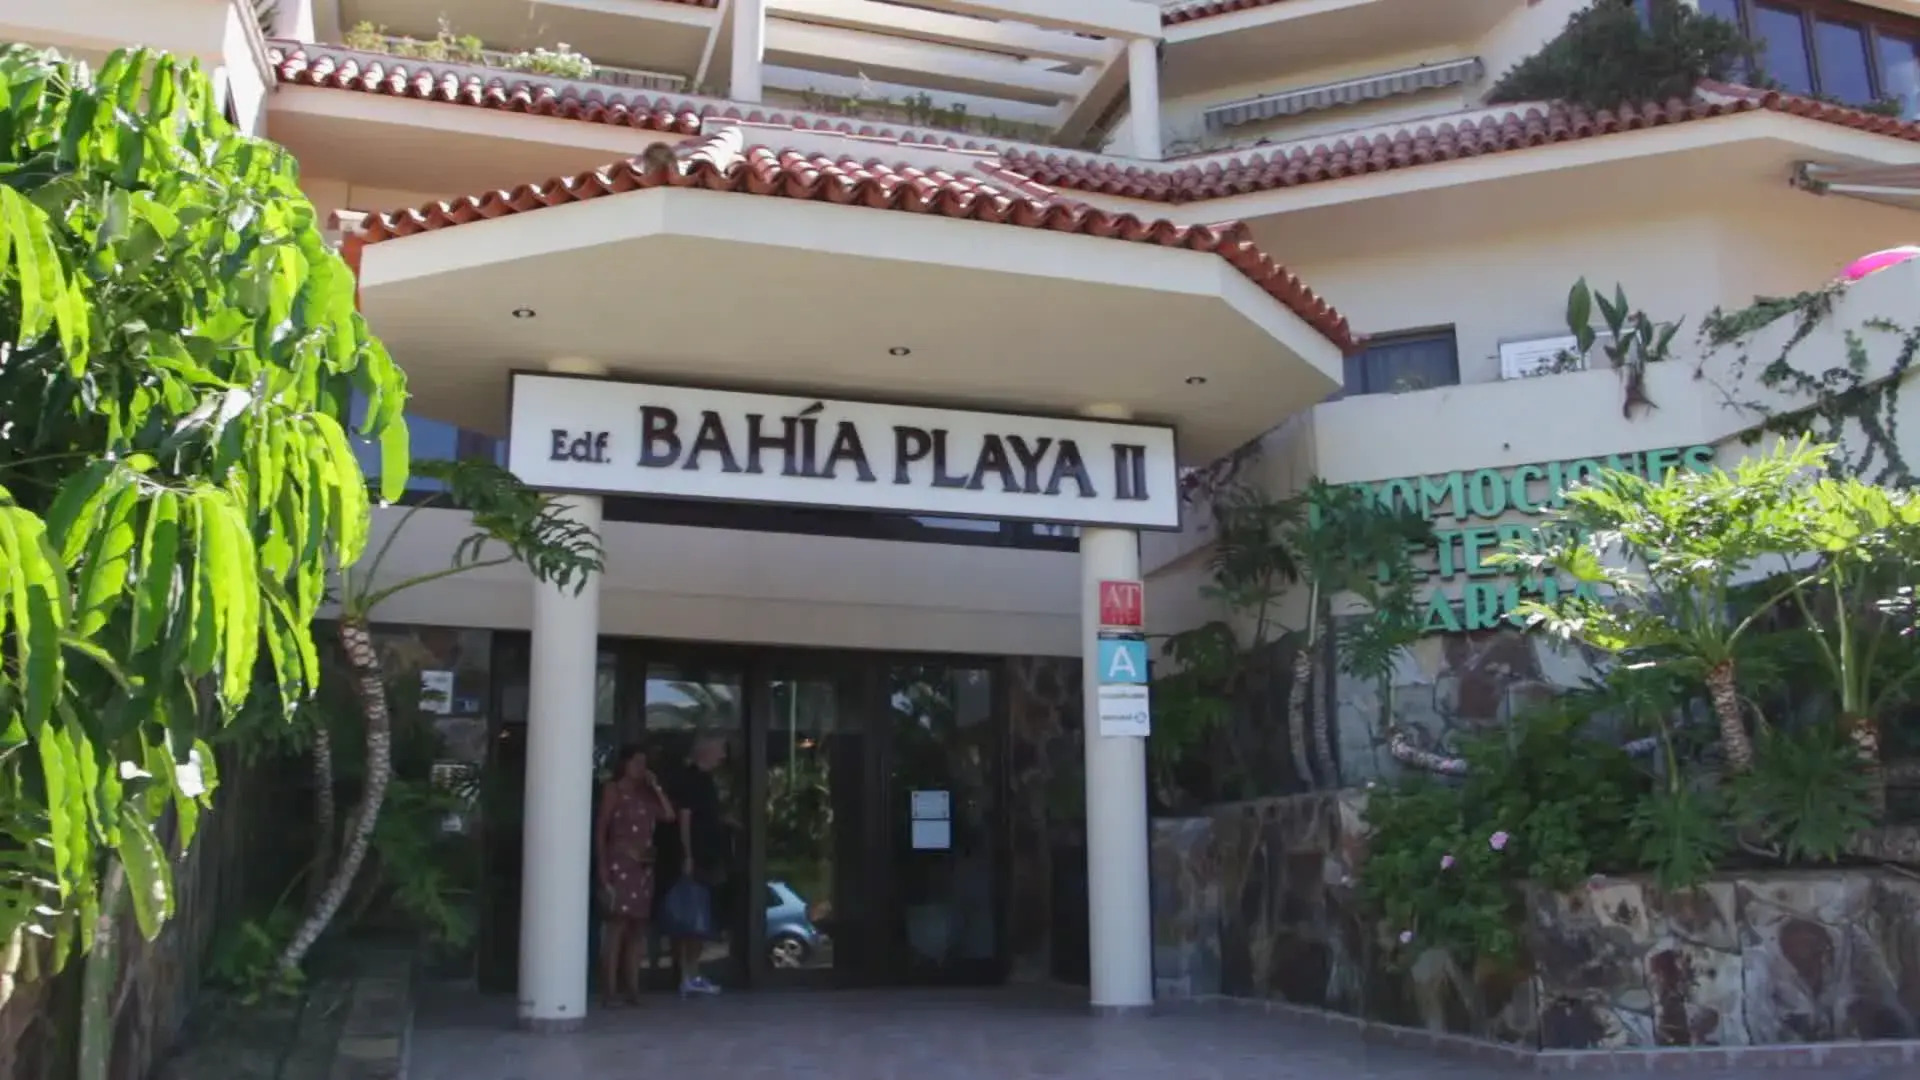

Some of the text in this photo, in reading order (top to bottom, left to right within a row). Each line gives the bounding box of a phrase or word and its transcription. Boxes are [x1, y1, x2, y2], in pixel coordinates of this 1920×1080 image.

[549, 401, 1150, 501] Edf. BAHÍA PLAYA II
[1108, 645, 1137, 678] A
